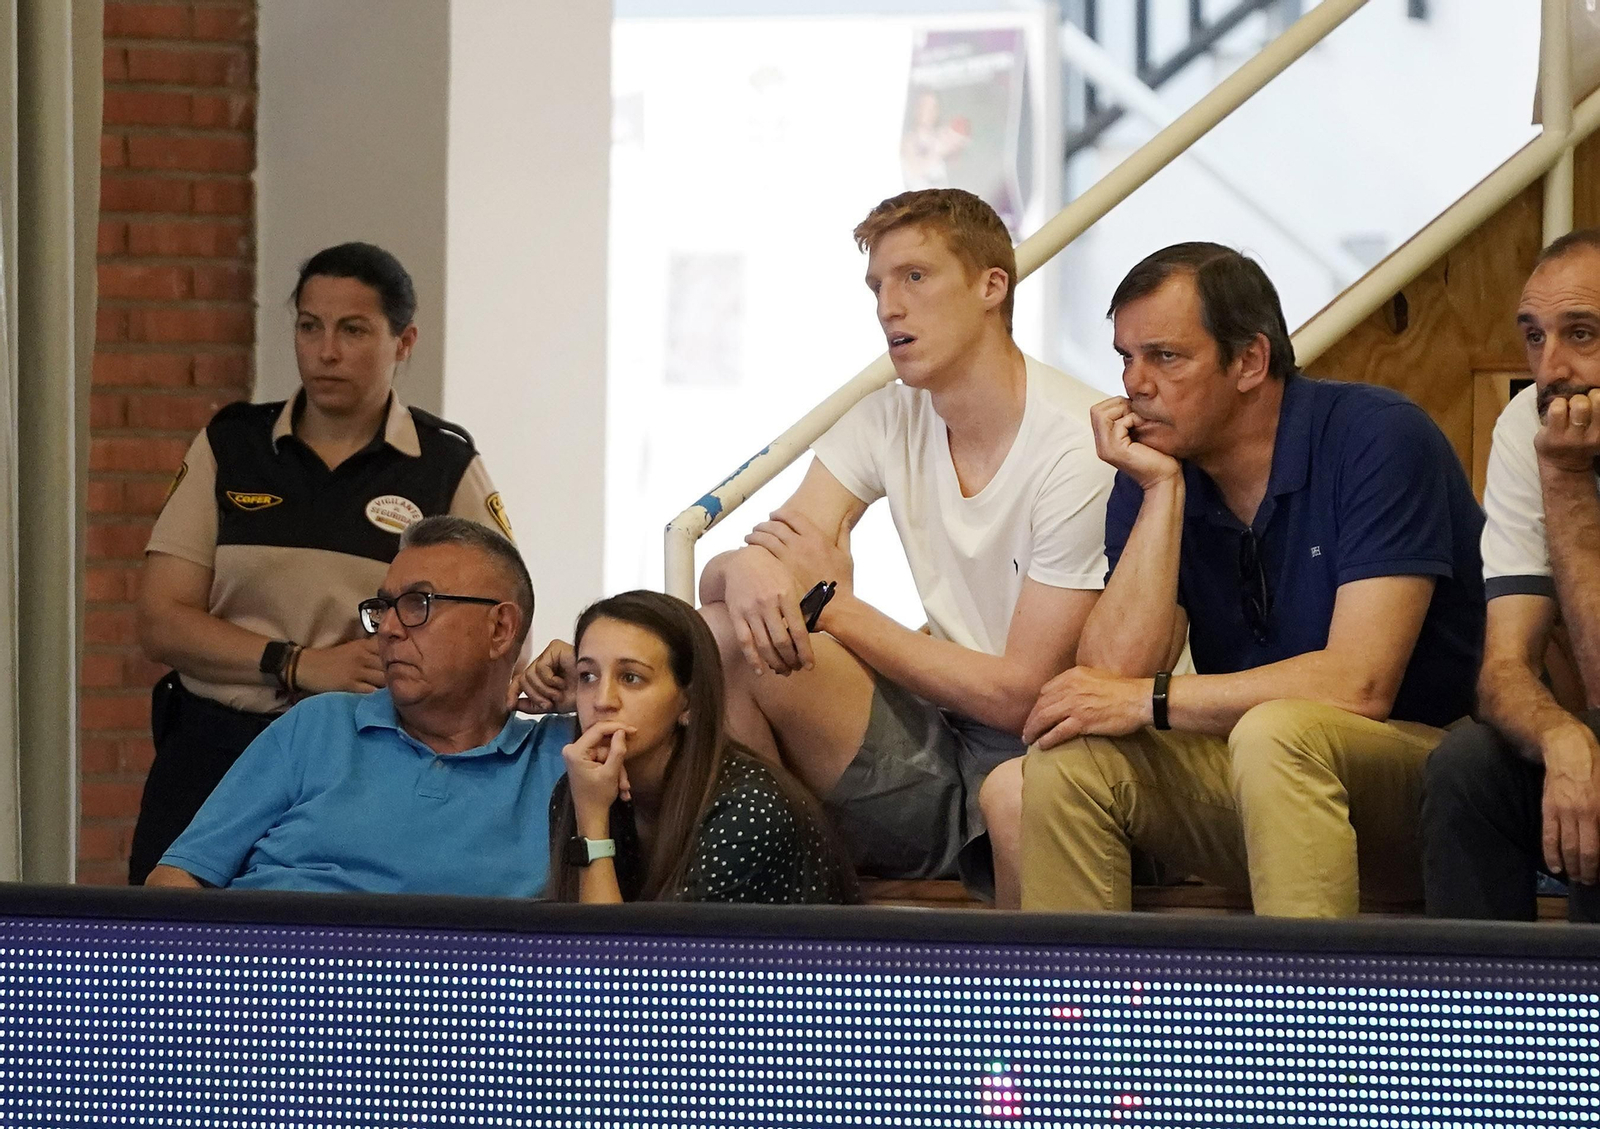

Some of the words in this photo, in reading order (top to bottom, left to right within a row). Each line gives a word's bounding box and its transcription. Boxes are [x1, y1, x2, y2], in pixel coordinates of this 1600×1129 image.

[235, 495, 271, 504] COFER
[370, 507, 412, 524] SEGURIDA
[374, 498, 420, 519] VIGILANTE
